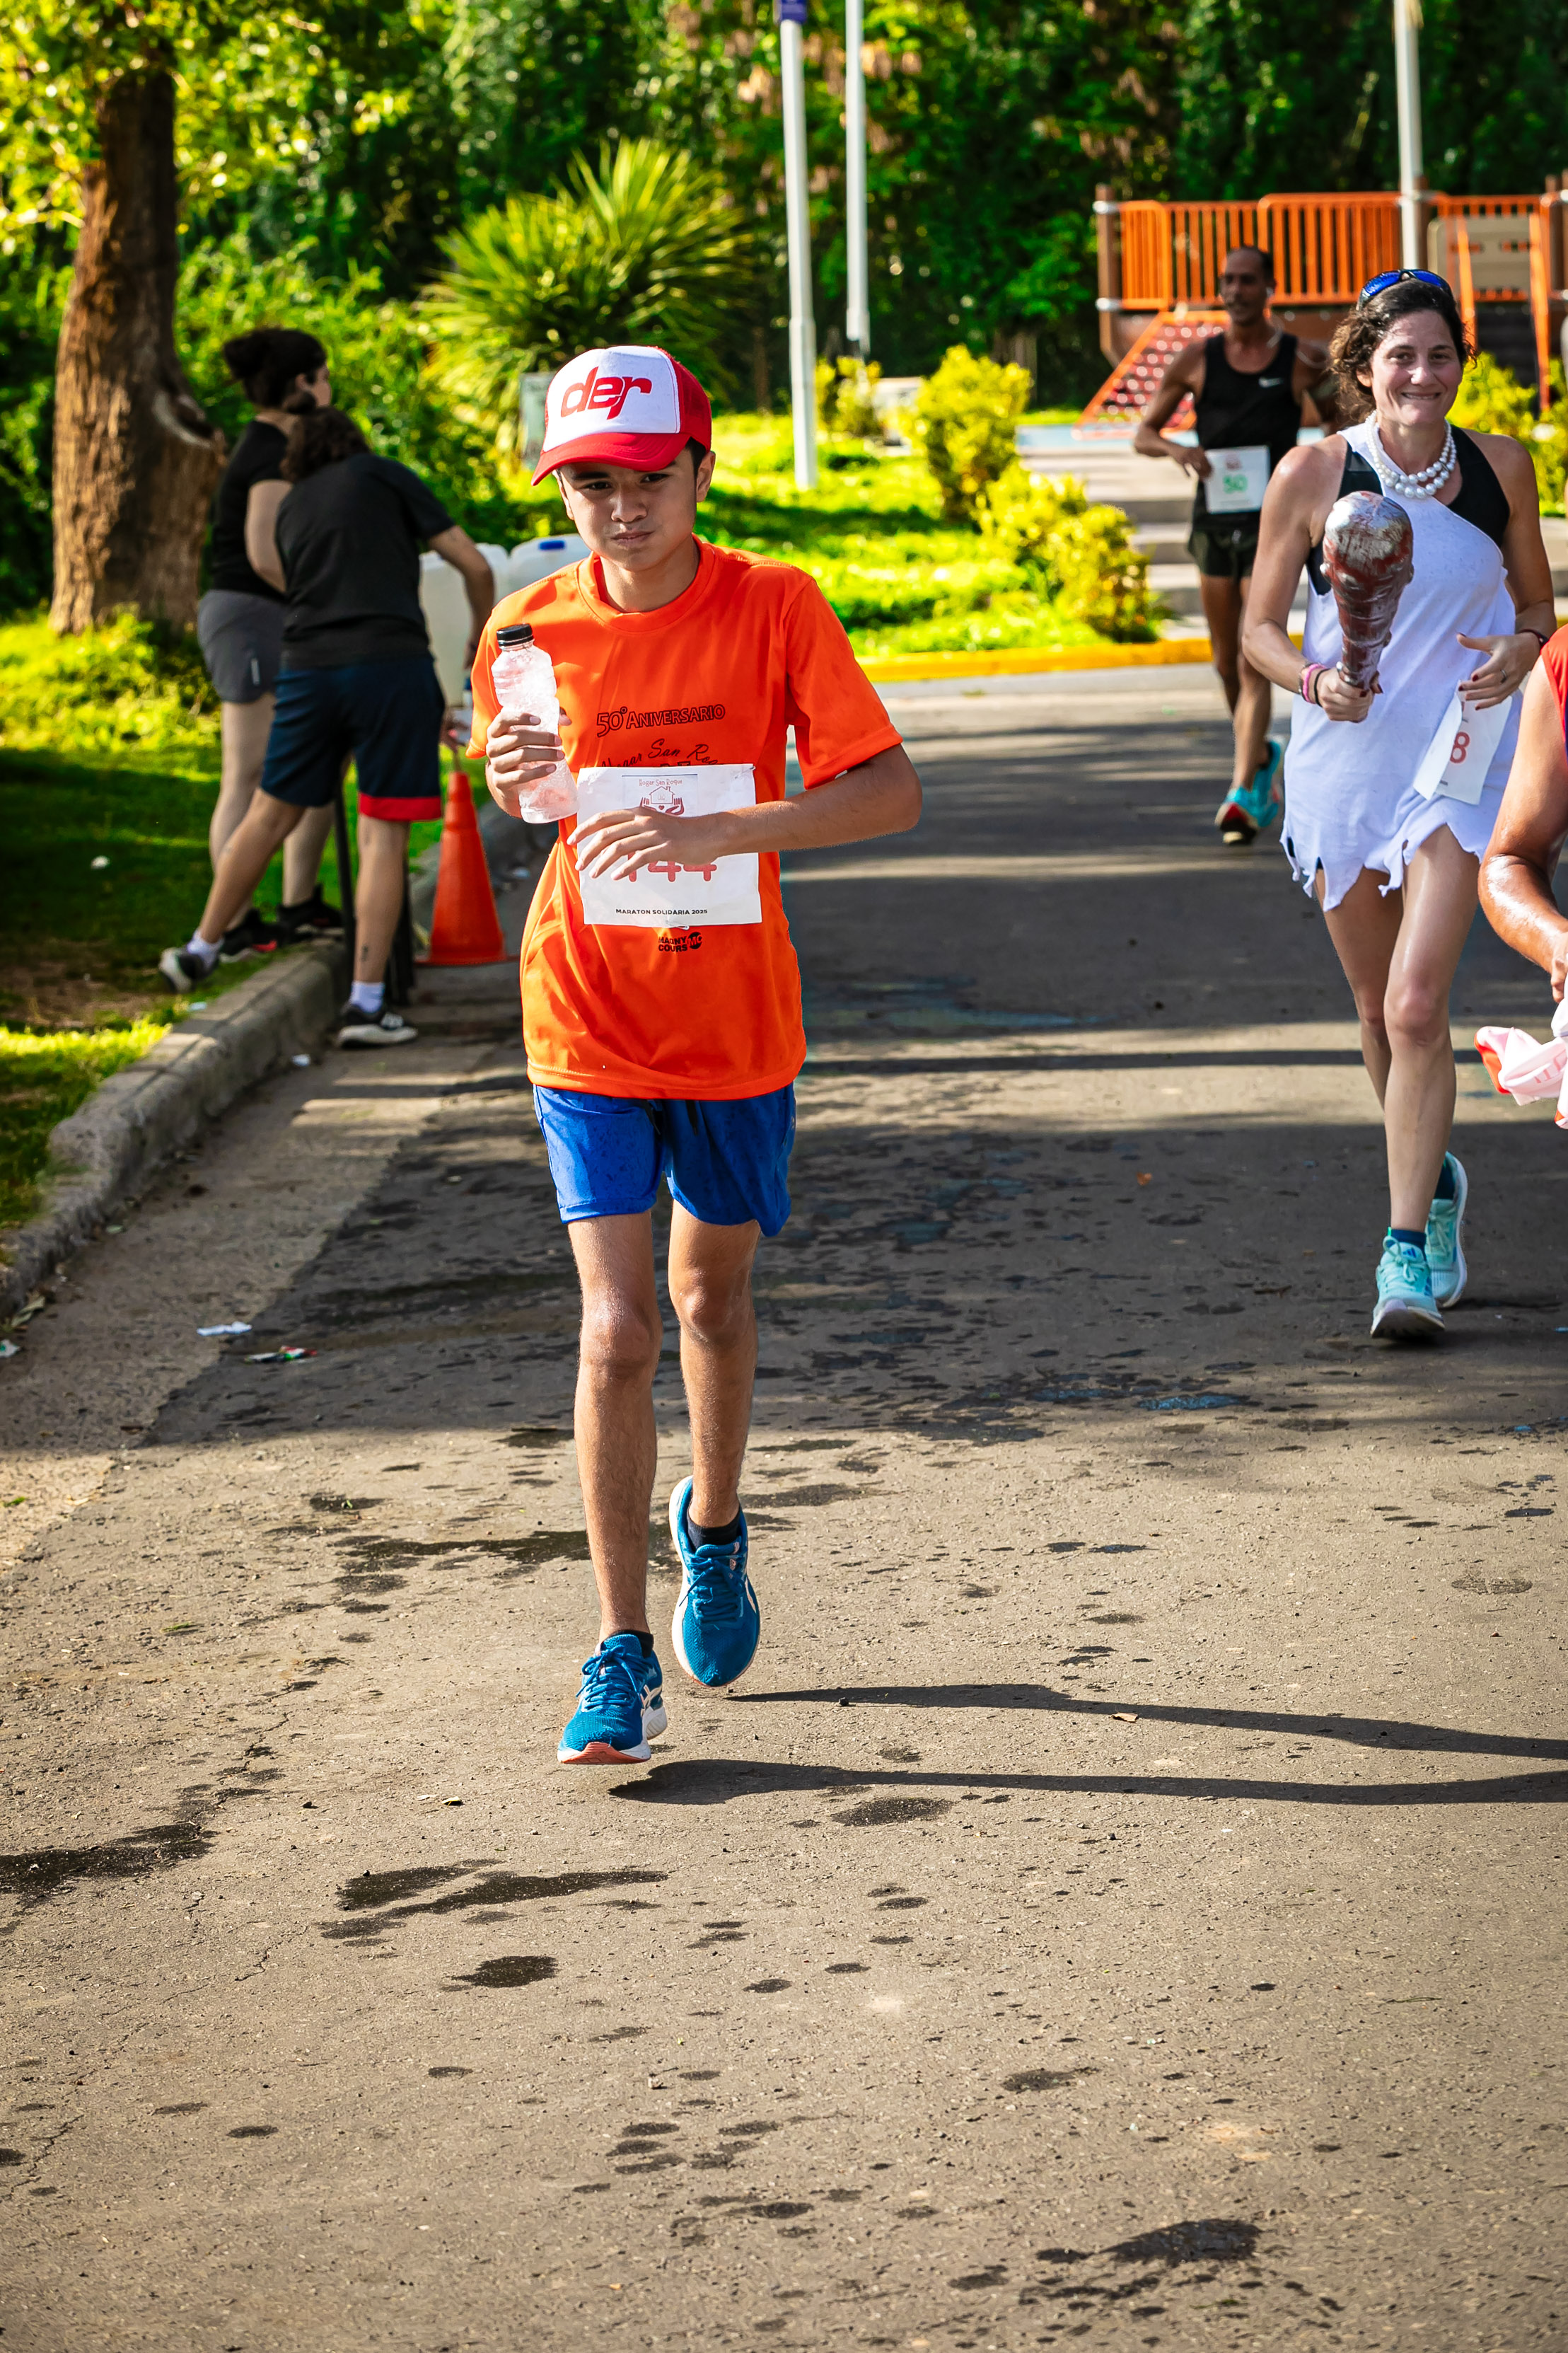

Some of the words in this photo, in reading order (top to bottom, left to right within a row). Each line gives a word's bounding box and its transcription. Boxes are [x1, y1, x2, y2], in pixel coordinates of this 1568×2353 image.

[561, 366, 652, 420] der
[626, 704, 726, 729] ANIVERSARIO
[648, 738, 680, 758] San
[658, 944, 687, 952] COURS
